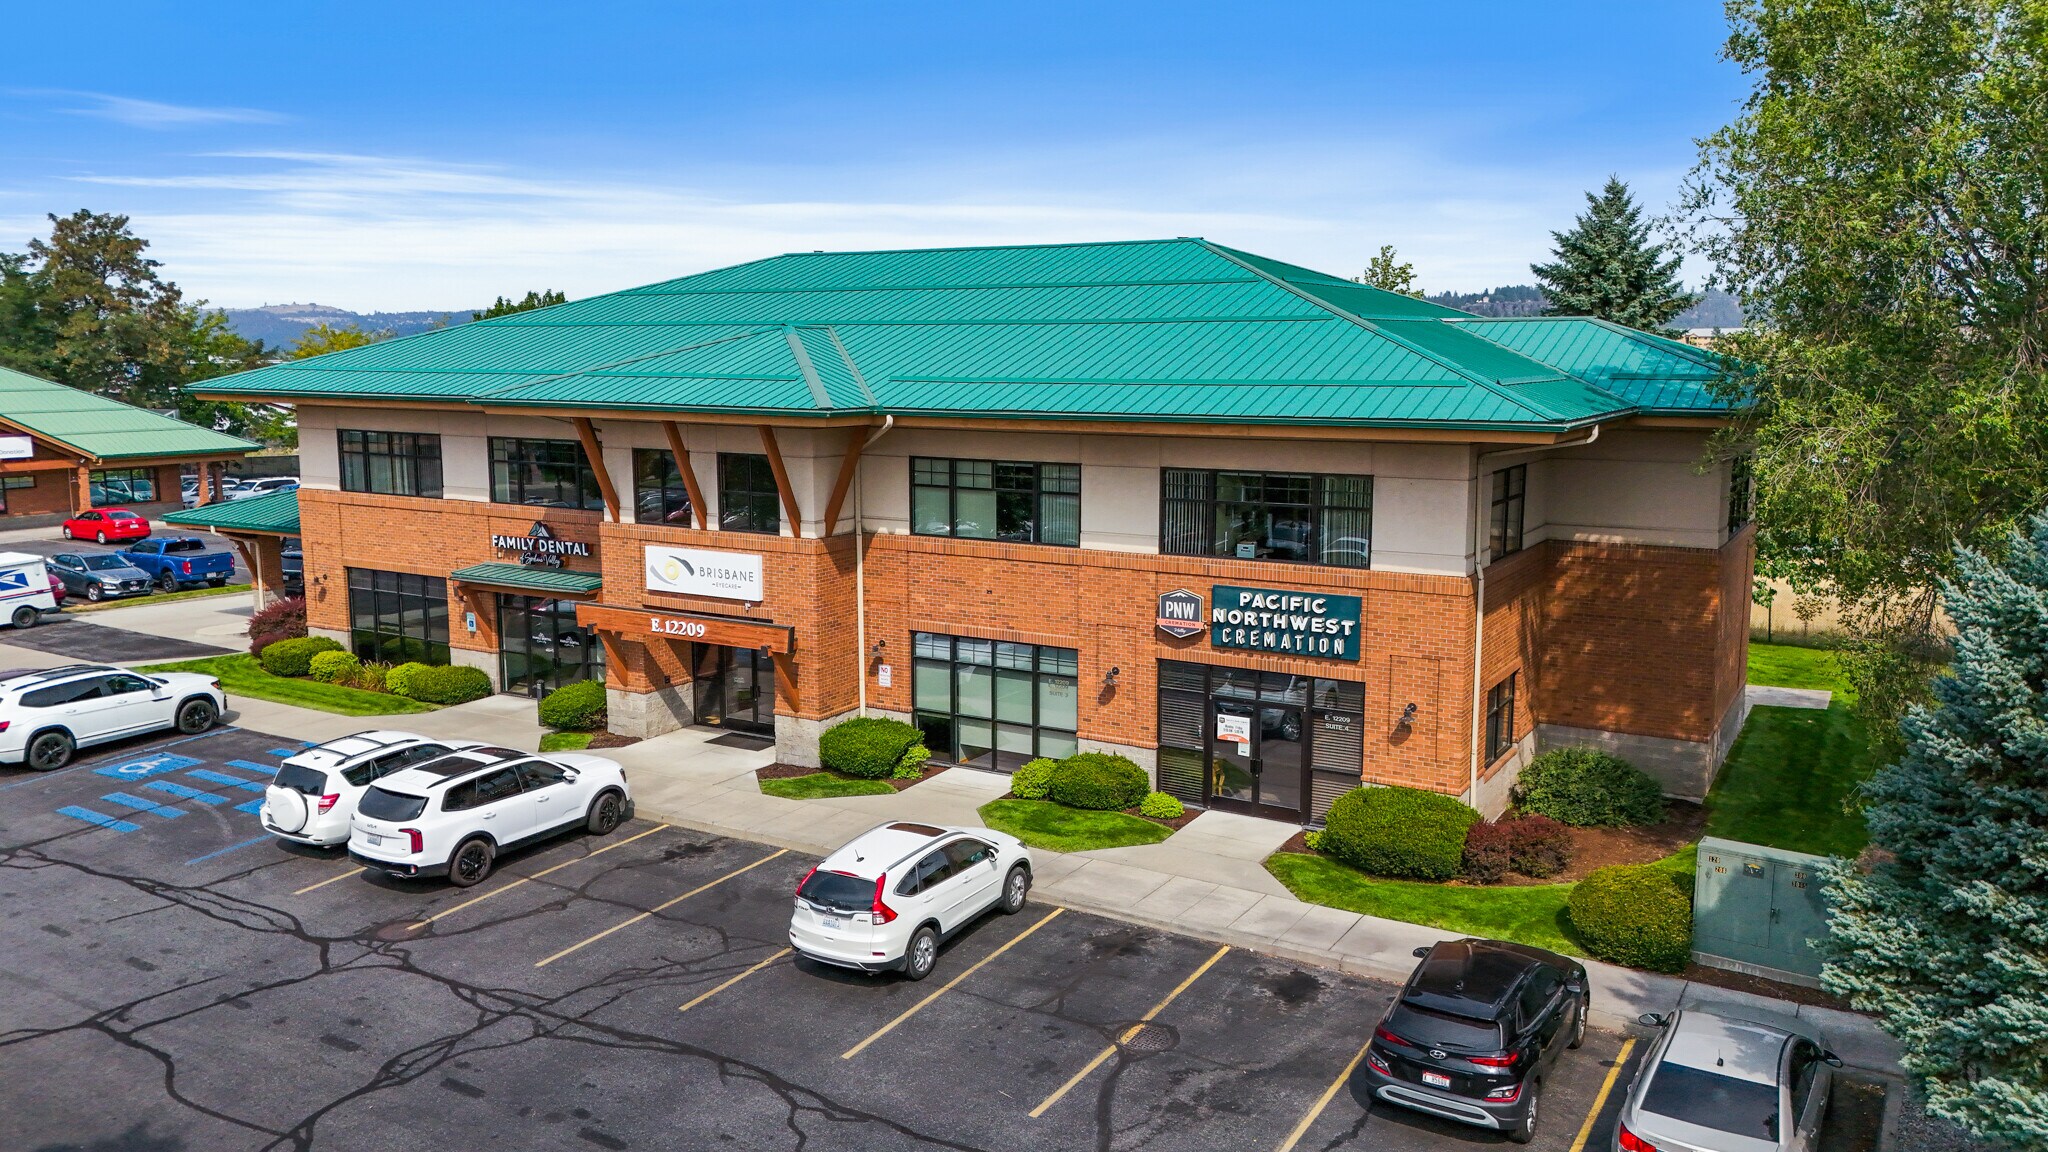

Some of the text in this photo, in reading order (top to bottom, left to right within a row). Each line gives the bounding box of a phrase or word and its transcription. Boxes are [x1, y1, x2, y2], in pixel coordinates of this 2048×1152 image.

[492, 535, 589, 556] FAMILY DENTAL
[699, 566, 754, 583] BRISBANE
[1165, 601, 1195, 620] PNW
[1240, 592, 1327, 614] PACIFIC
[1164, 620, 1196, 628] CREMATION
[1212, 608, 1356, 636] NORTHWEST
[1222, 627, 1345, 655] CREMATION
[1325, 722, 1343, 731] SUITE
[1332, 715, 1351, 723] 12209
